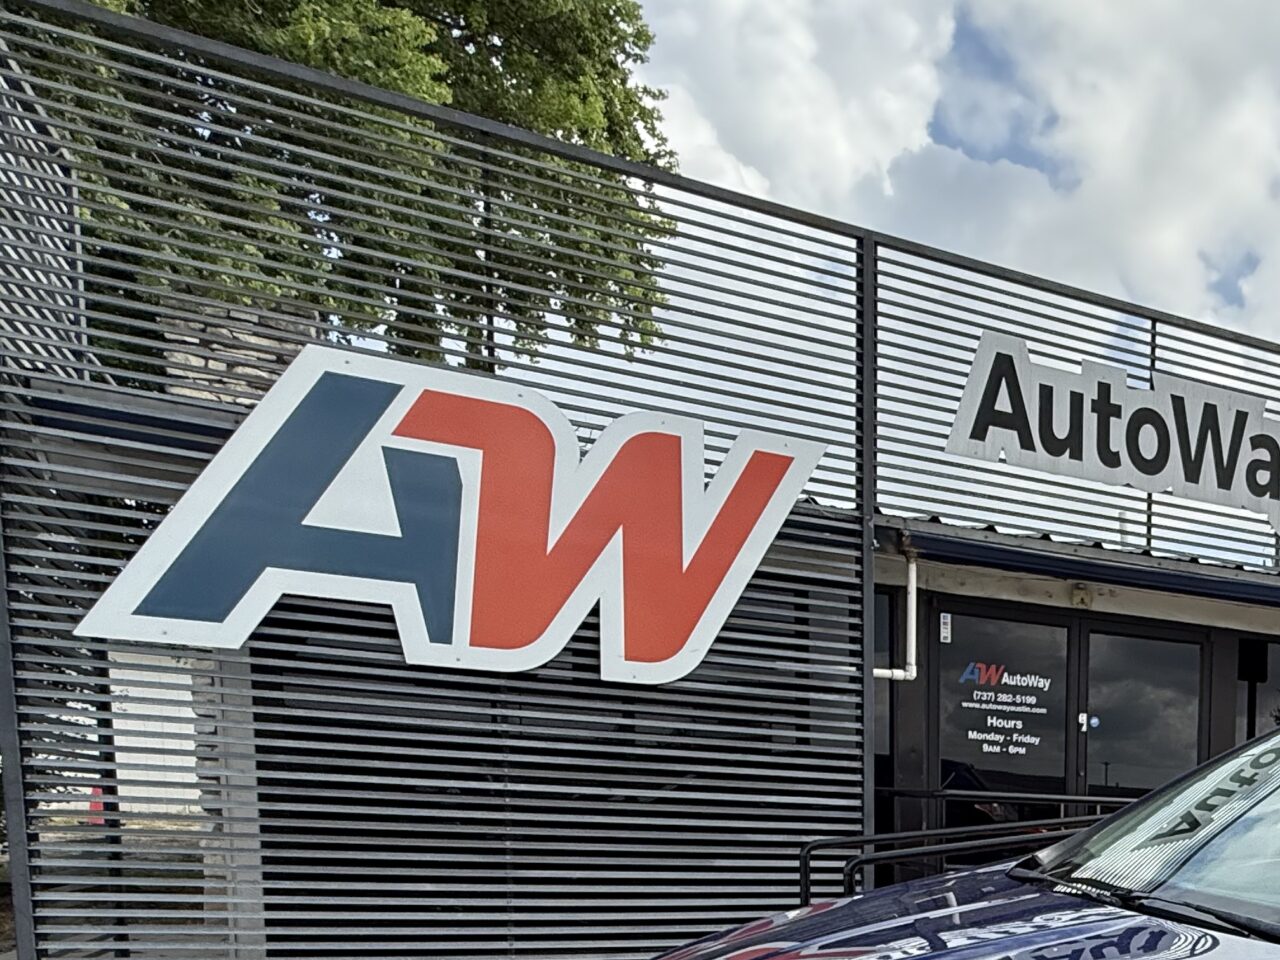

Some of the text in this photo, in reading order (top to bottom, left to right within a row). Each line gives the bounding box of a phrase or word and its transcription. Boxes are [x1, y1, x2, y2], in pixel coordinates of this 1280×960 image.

[132, 371, 795, 664] AW
[959, 662, 1051, 691] AW AutoWay
[973, 690, 1037, 705] (737) 282-5199
[987, 715, 1023, 729] Hours
[968, 730, 1005, 743] Monday
[1013, 733, 1040, 745] Friday
[983, 743, 1001, 753] 9AM
[1009, 745, 1026, 754] 6PM
